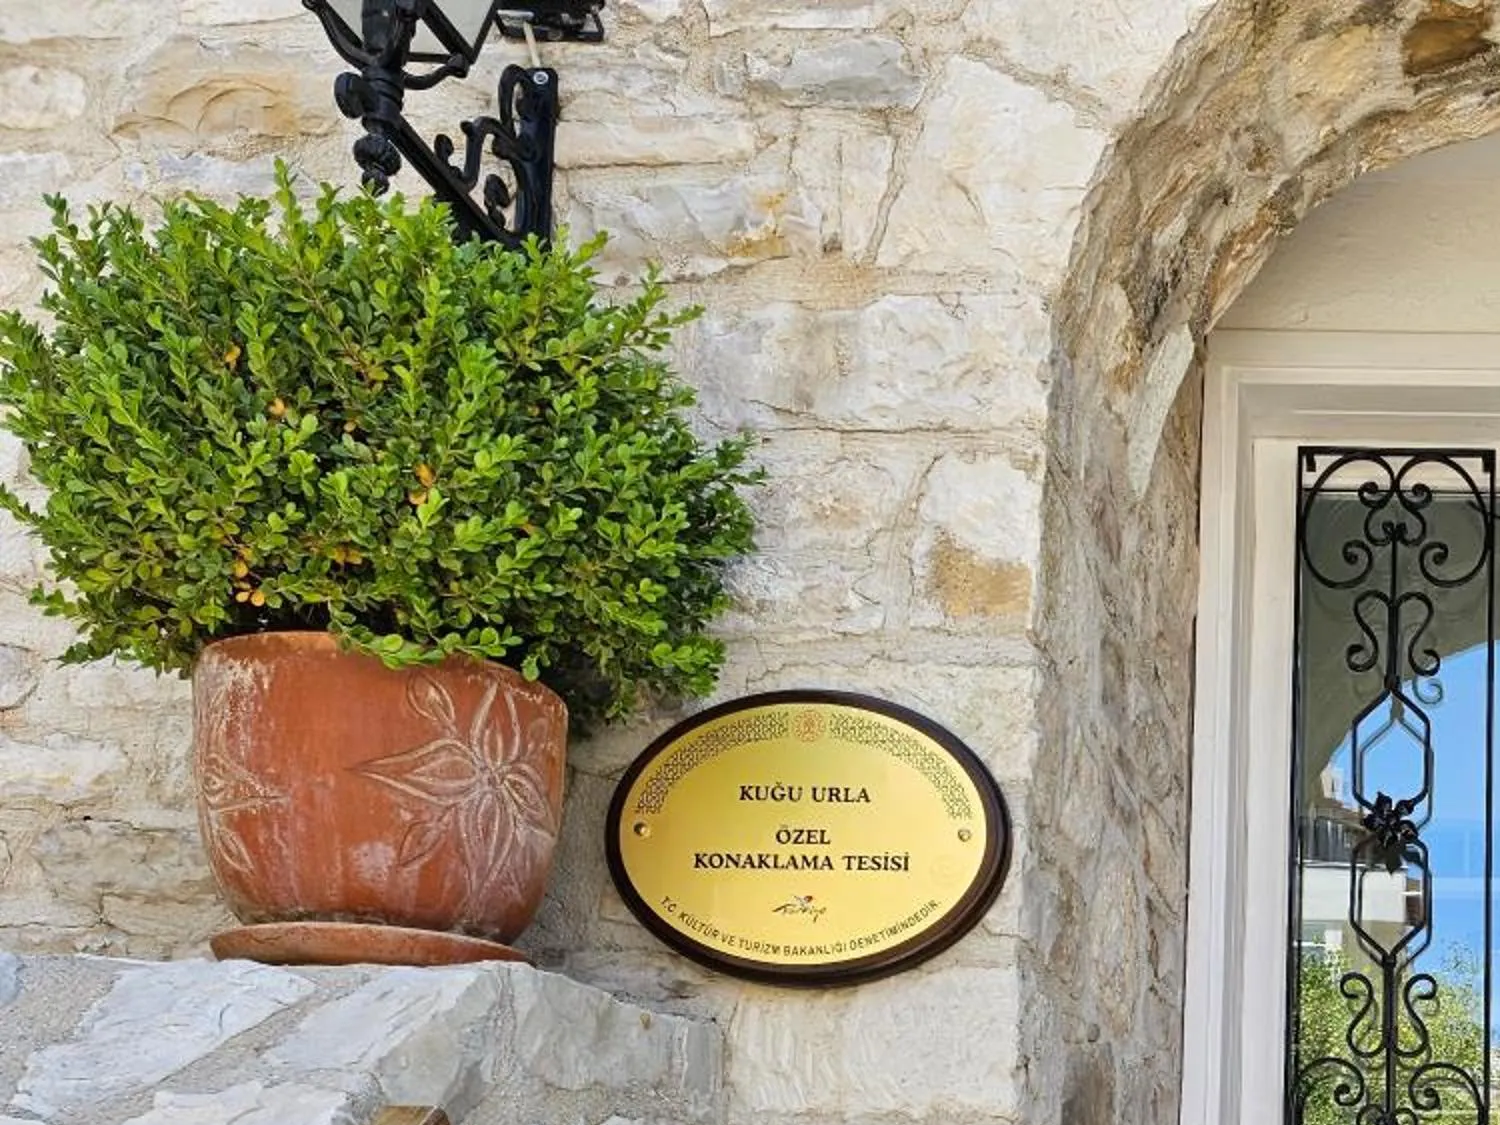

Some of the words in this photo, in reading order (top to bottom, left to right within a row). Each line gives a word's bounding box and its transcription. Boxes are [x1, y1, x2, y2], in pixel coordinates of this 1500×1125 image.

[739, 781, 803, 802] KUĞU
[811, 786, 871, 803] URLA
[775, 824, 831, 845] ÖZEL
[694, 852, 834, 870] KONAKLAMA
[841, 851, 910, 872] TESİSİ
[679, 911, 720, 938] KÜLTÜR
[721, 934, 735, 947] VE
[739, 938, 781, 955] TURİZM
[783, 940, 847, 957] BAKANLIĞI
